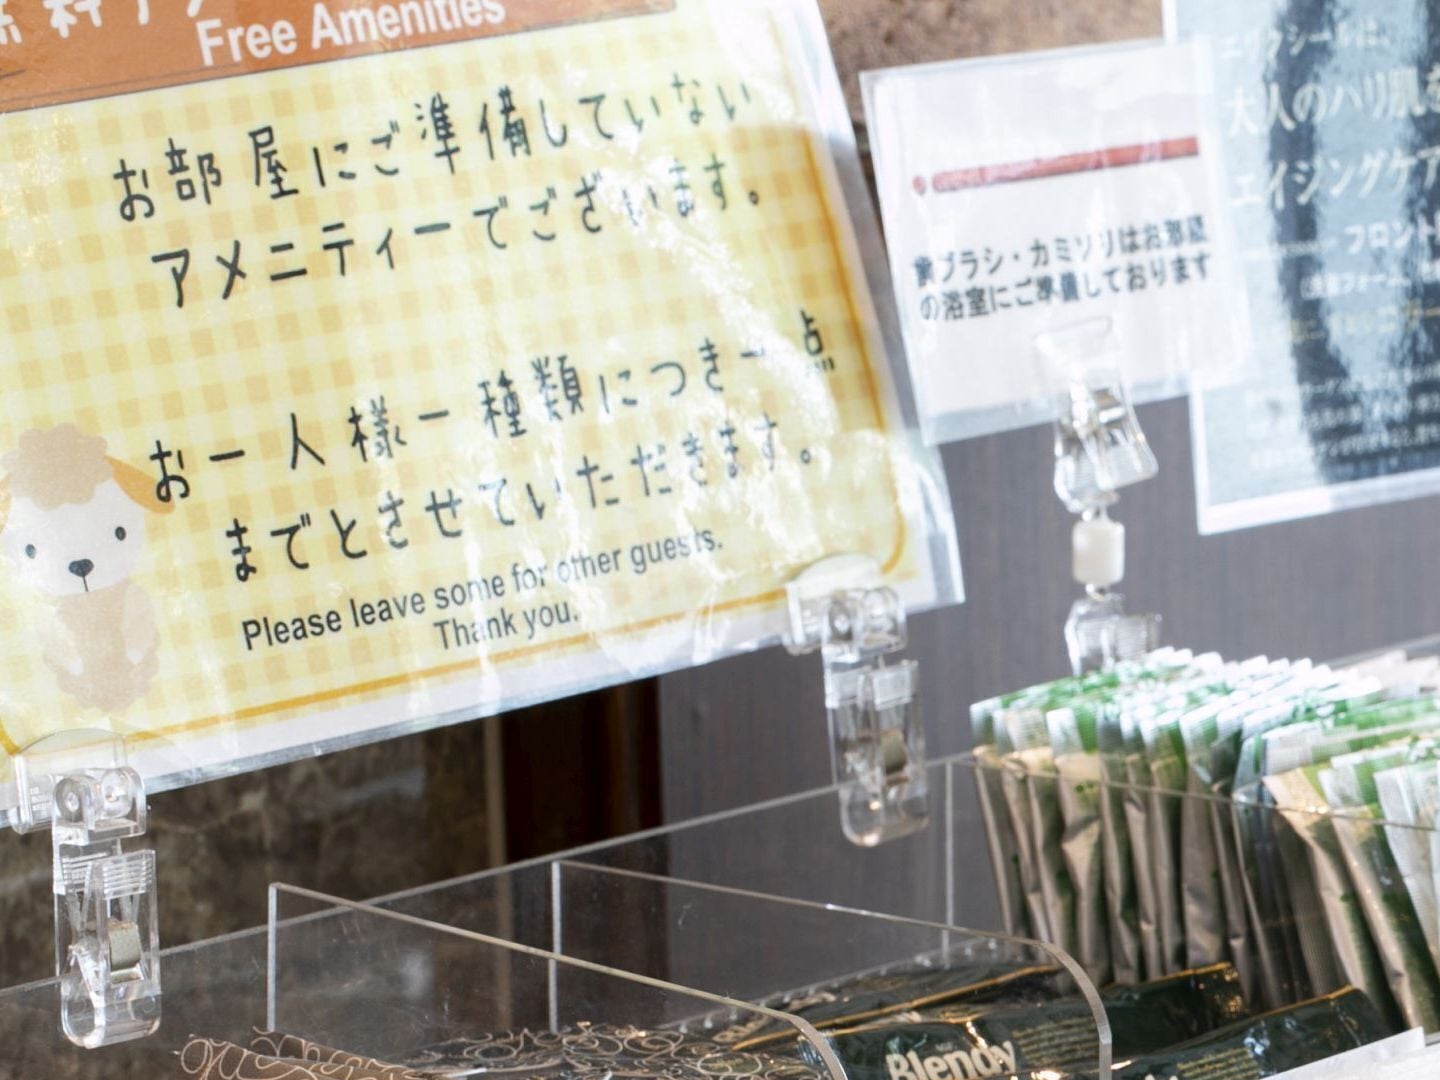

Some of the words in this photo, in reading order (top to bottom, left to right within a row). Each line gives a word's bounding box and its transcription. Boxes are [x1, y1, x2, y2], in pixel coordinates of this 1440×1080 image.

[197, 19, 298, 66] Free
[312, 0, 507, 49] Amenities
[114, 73, 751, 224] お部屋にご準備していない
[152, 152, 760, 309] アメニティーでございます。
[224, 412, 812, 583] までとさせていただきます。
[242, 610, 342, 651] Please
[350, 589, 426, 630] leave
[434, 576, 506, 609] some
[511, 562, 548, 594] for
[557, 547, 621, 585] other
[631, 528, 724, 576] guests.
[434, 610, 515, 651] Thank
[523, 601, 579, 641] you.
